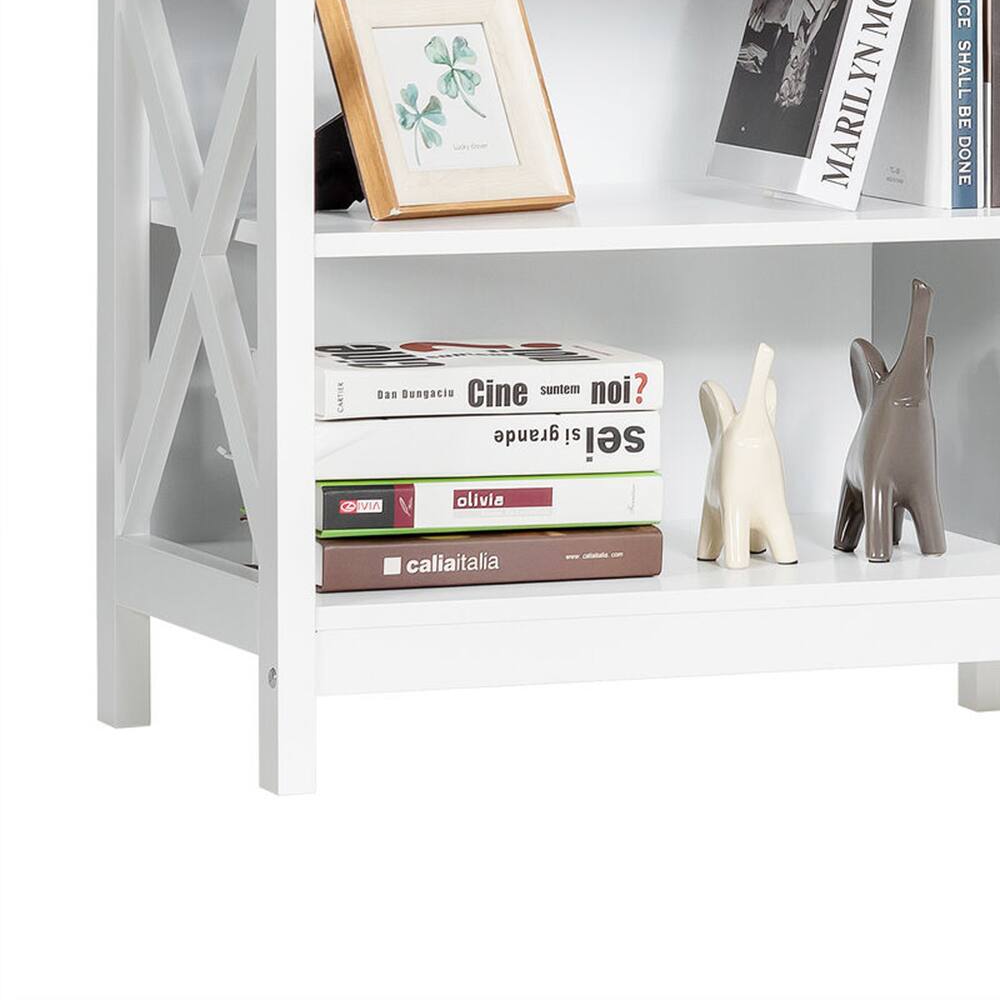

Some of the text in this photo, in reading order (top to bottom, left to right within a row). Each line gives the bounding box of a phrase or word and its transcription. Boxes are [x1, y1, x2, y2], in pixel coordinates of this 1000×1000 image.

[958, 41, 971, 99] SHALL
[821, 40, 884, 189] MARILYN
[958, 106, 971, 129] BE
[958, 135, 972, 186] DONE
[377, 373, 648, 408] Dan Dungaciu Cine suntem noi?
[494, 424, 646, 462] sei si grande
[457, 491, 504, 507] olivia
[406, 553, 499, 574] caliaitalia
